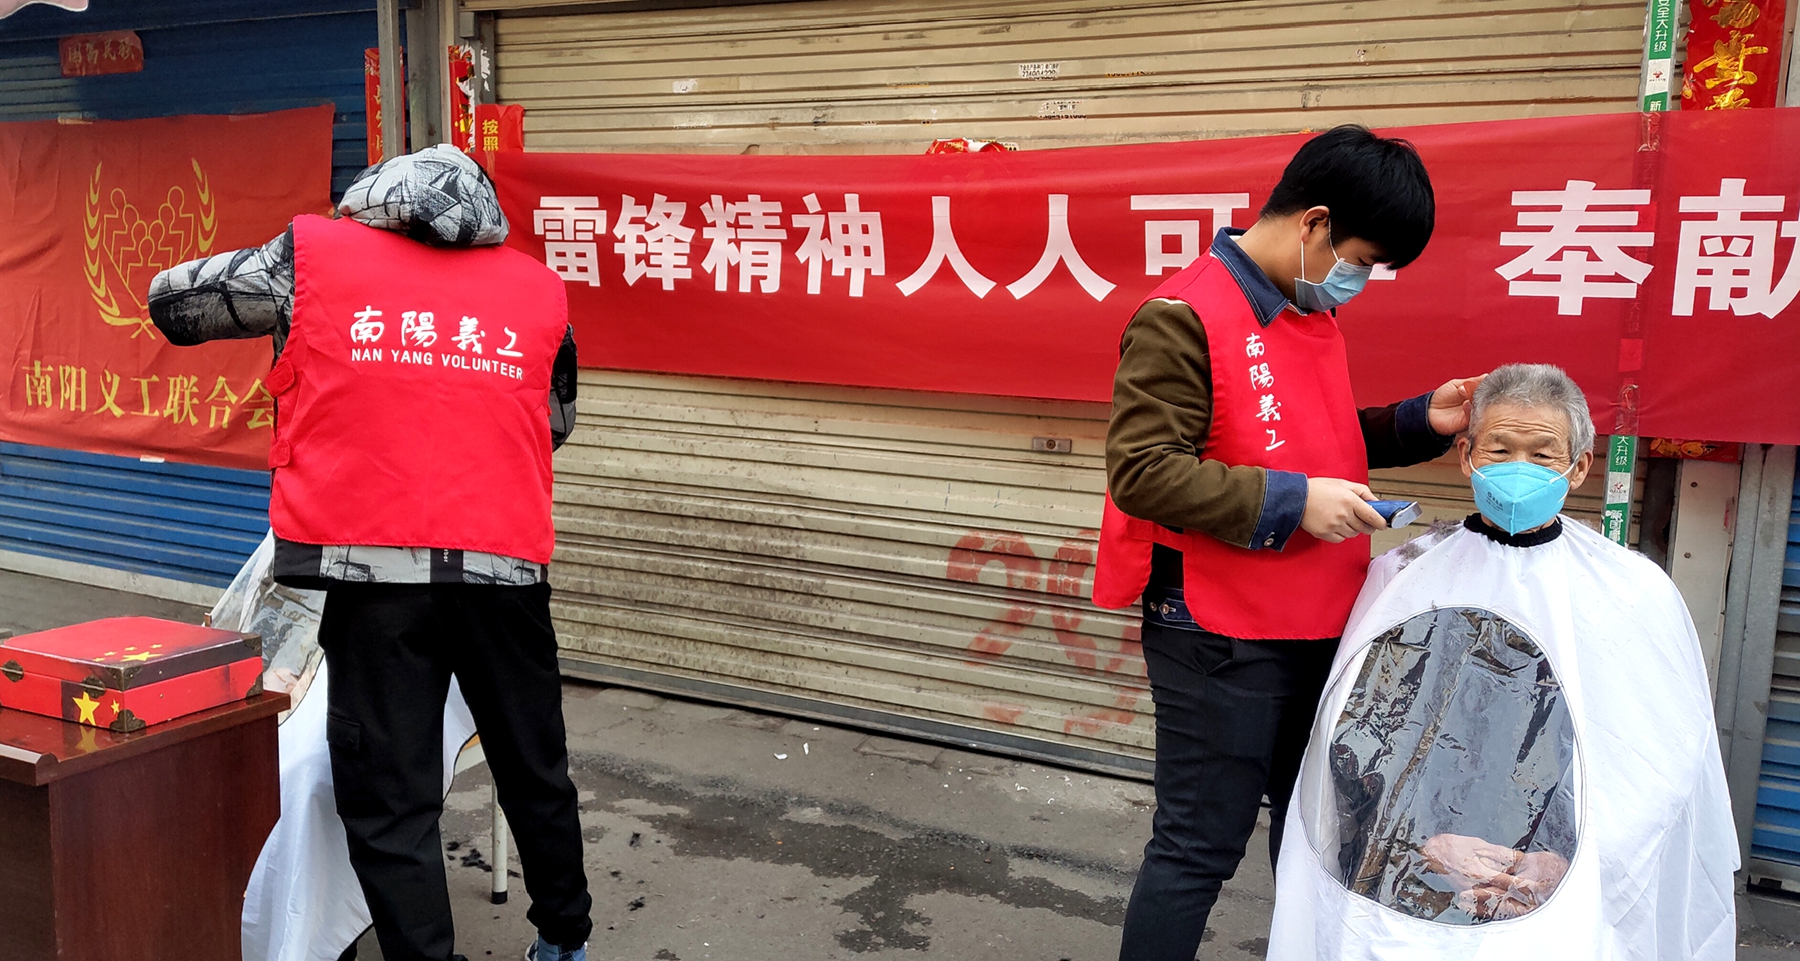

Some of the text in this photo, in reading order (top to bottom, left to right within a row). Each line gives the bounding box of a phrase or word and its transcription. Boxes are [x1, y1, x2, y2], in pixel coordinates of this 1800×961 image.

[533, 192, 1396, 301] 雷锋精神人人可
[22, 360, 274, 429] 南阳义工联合会
[351, 348, 523, 380] NAN YANG VOLUNTEER
